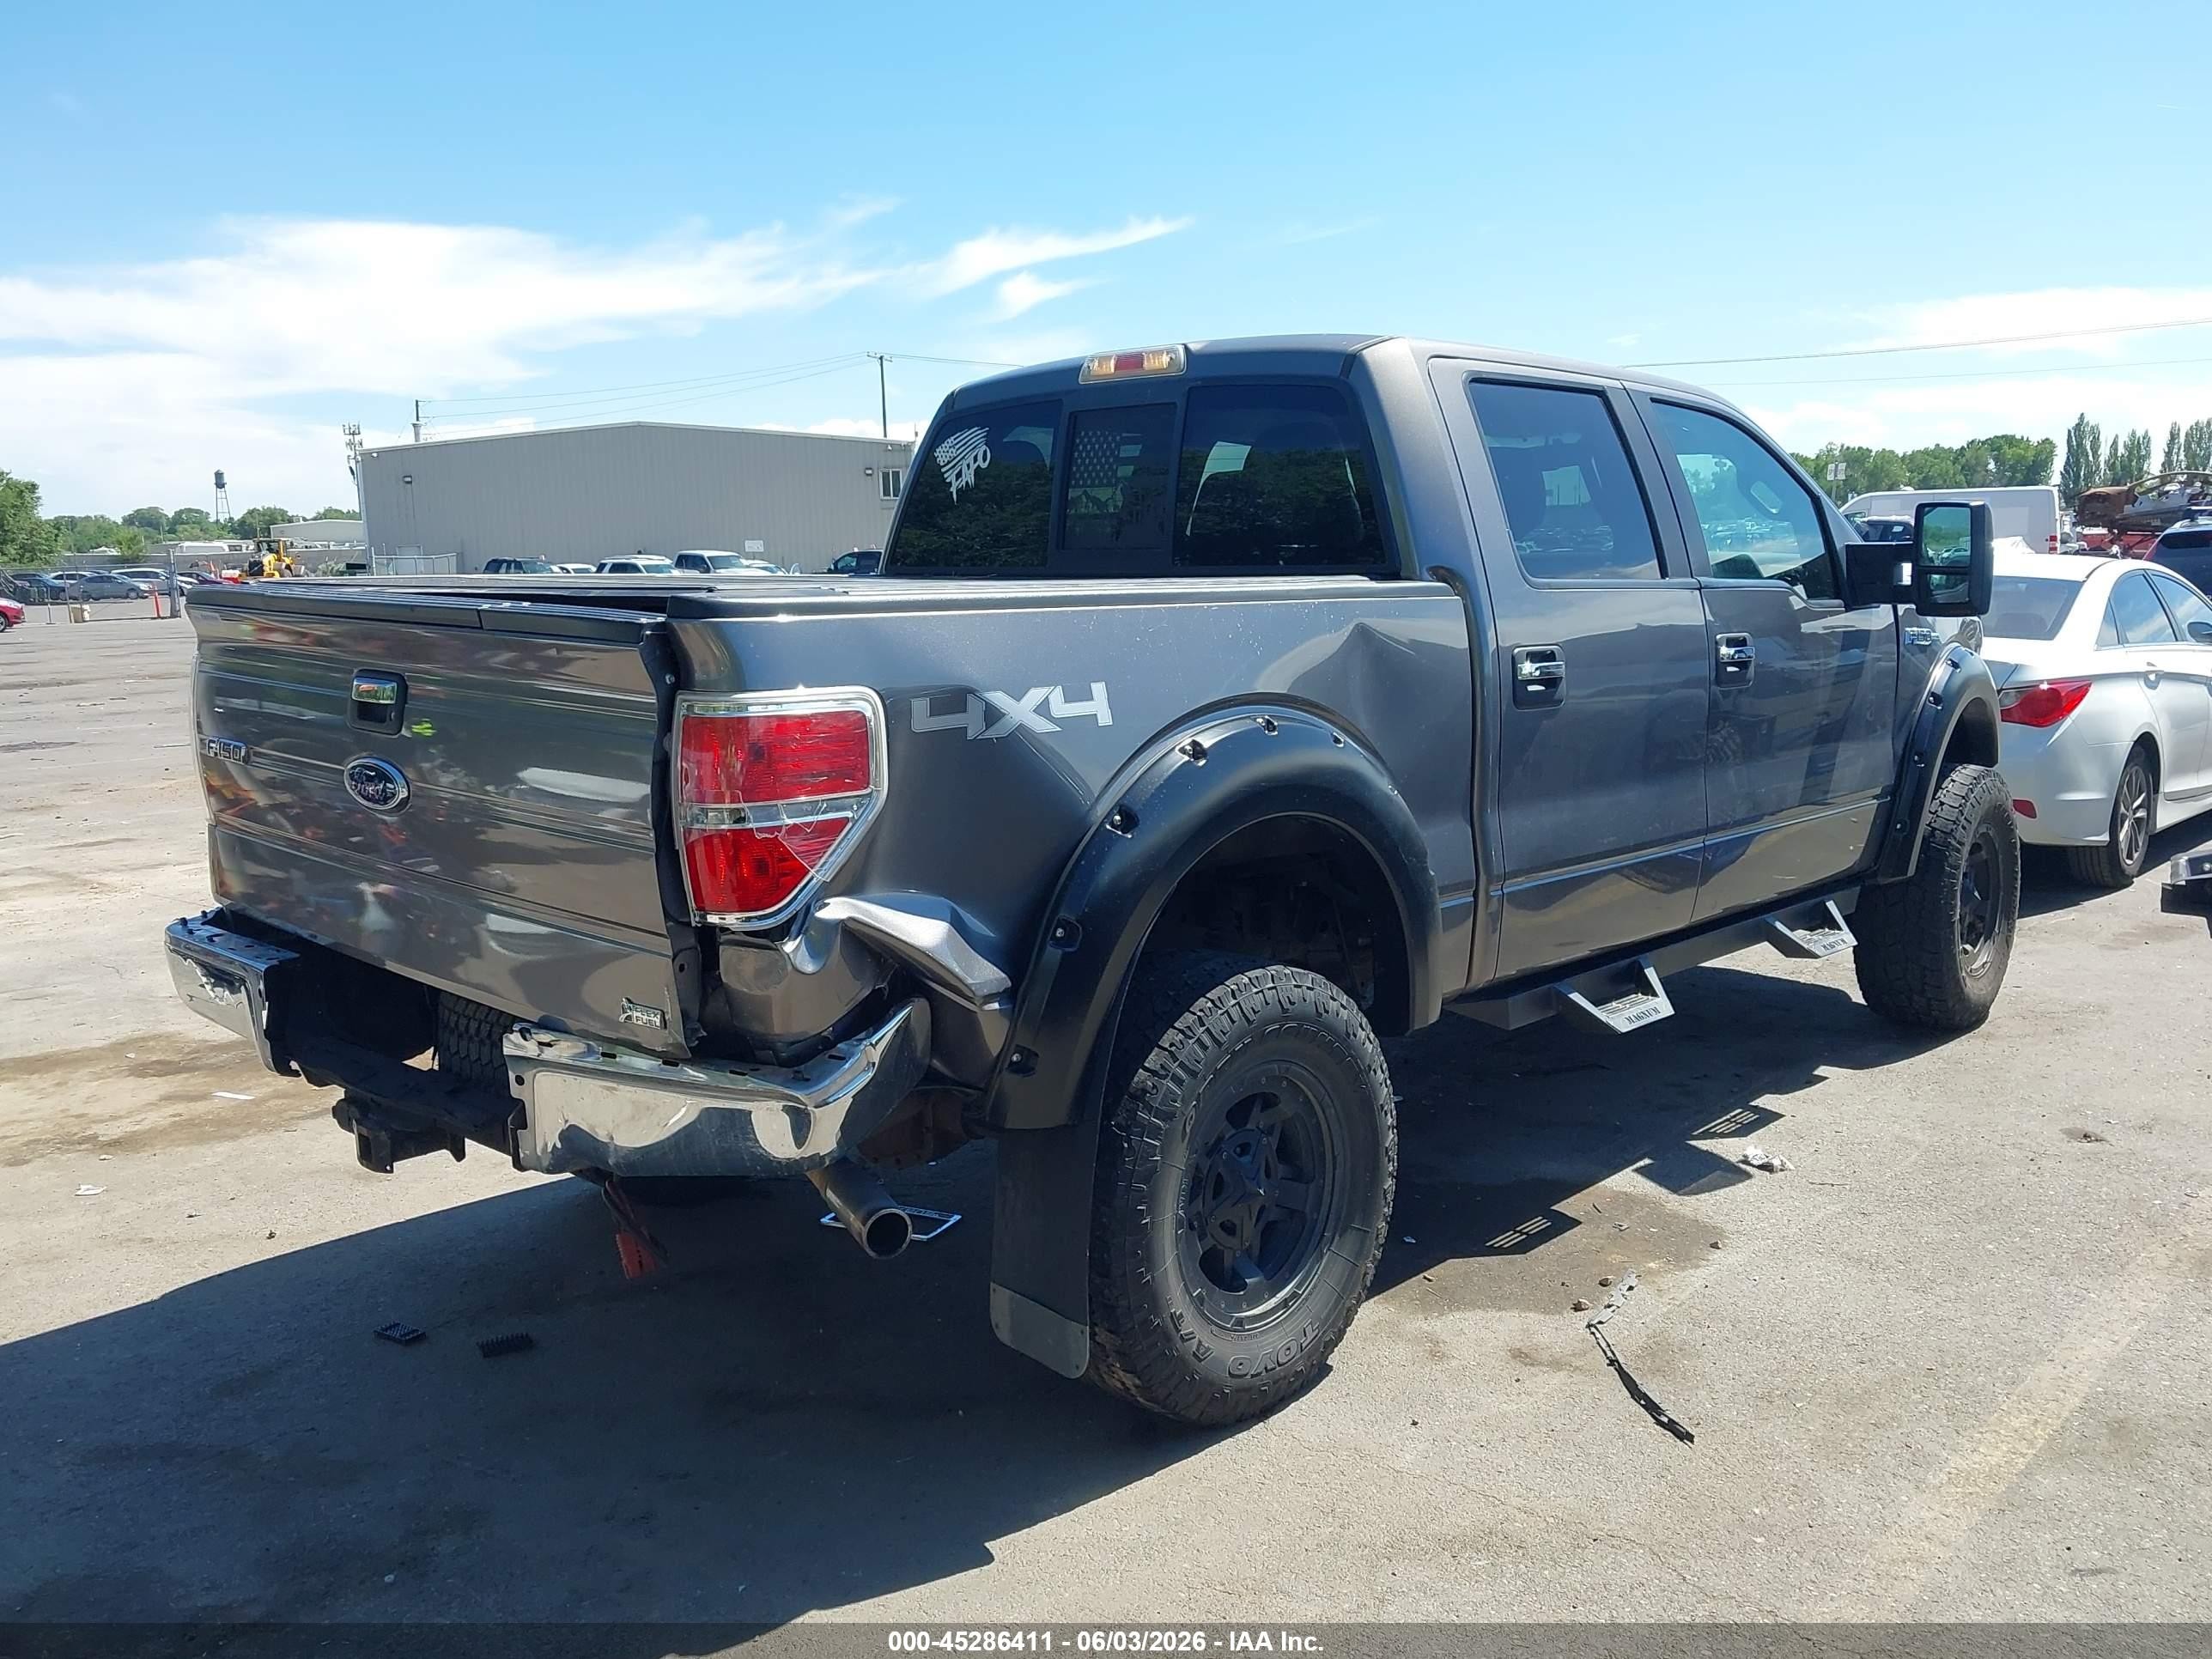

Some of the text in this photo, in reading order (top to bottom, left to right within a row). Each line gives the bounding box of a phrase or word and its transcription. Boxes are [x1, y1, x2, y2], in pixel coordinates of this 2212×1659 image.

[949, 445, 991, 505] FAFO
[634, 1006, 660, 1019] FLEX
[635, 1015, 660, 1028] FUEL
[1624, 1006, 1661, 1024] MAGNUM
[1228, 1320, 1319, 1379] TOYO
